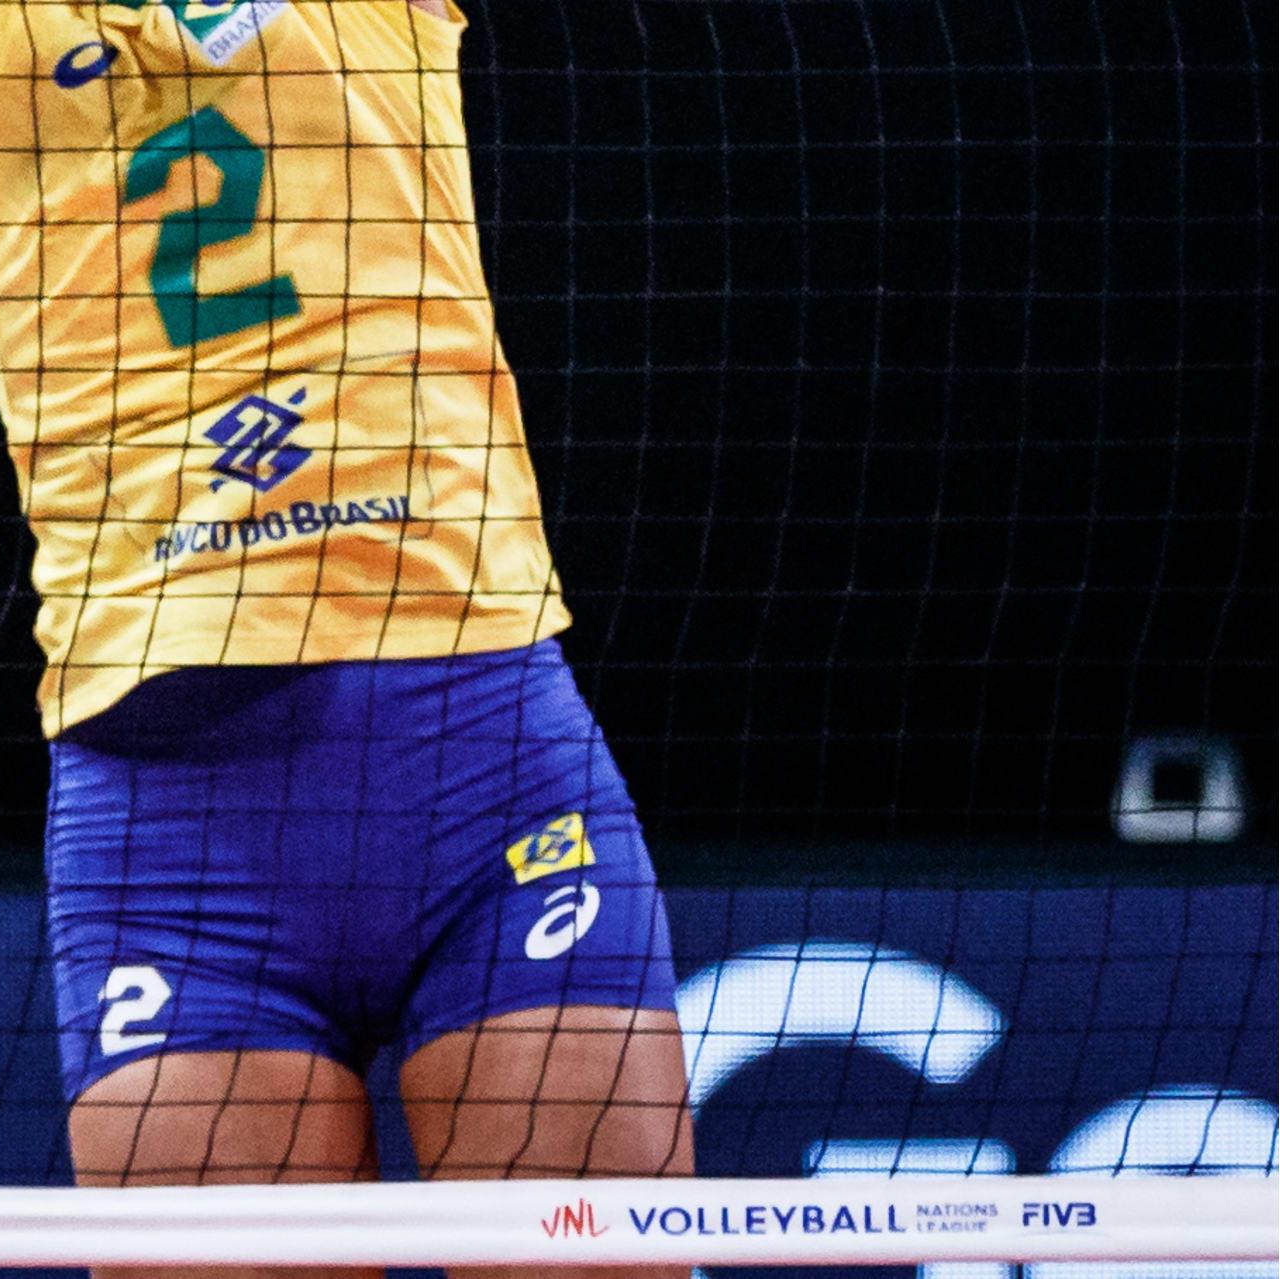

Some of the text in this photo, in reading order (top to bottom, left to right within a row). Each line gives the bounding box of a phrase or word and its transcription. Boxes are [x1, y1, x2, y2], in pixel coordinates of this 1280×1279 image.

[124, 105, 304, 349] 2
[240, 510, 288, 547] DO
[98, 965, 173, 1057] 2
[540, 1197, 610, 1239] VNL
[628, 1206, 907, 1236] VOLLEYBALL
[916, 1204, 999, 1218] NATIONS
[1021, 1201, 1097, 1227] FIVB
